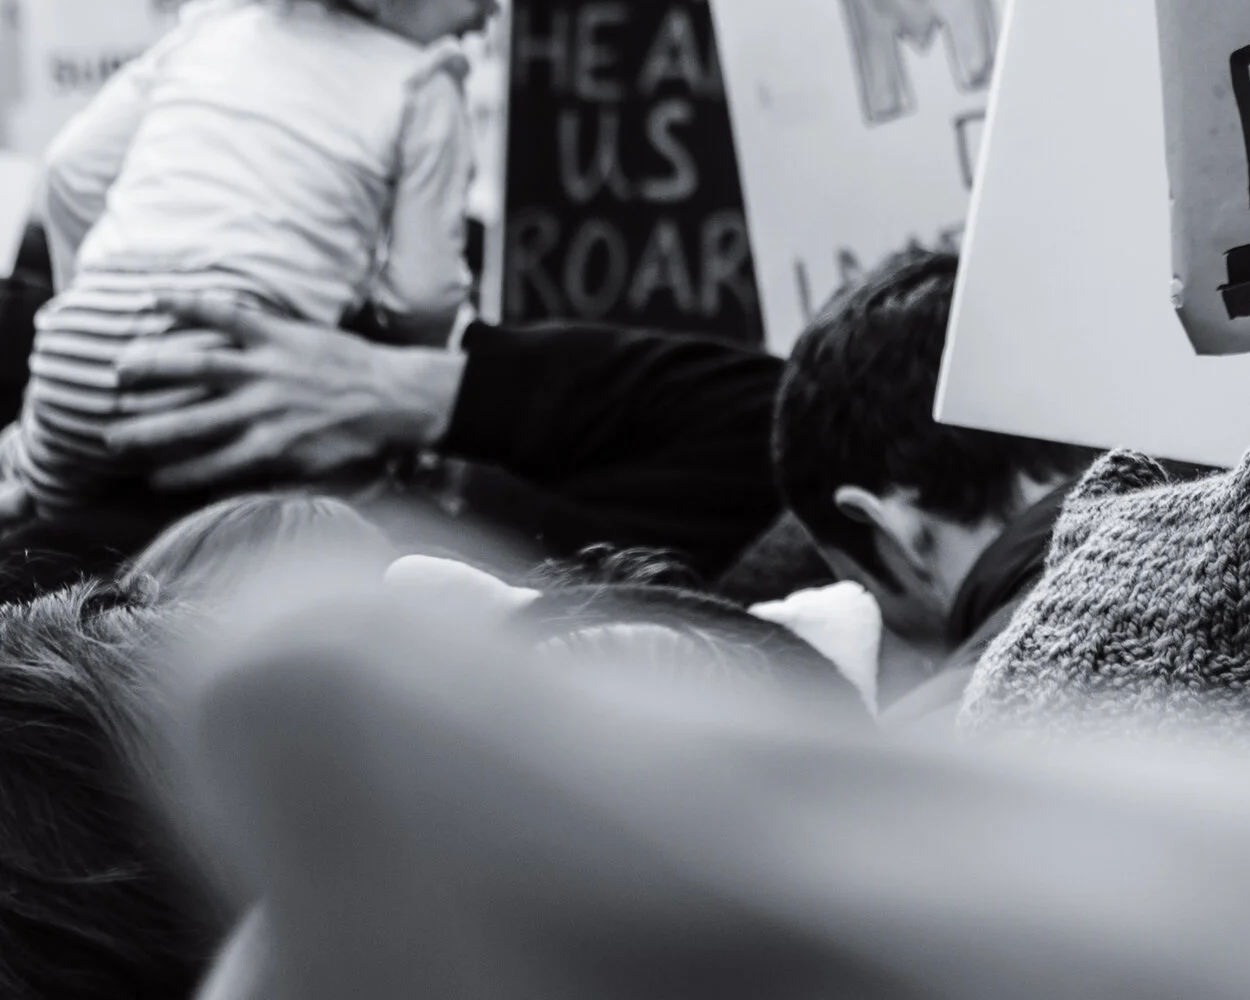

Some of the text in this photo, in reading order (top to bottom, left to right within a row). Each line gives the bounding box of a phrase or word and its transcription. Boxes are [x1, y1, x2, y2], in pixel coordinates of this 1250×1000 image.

[512, 2, 724, 100] HEA
[556, 100, 698, 202] US
[506, 206, 764, 318] ROAR
